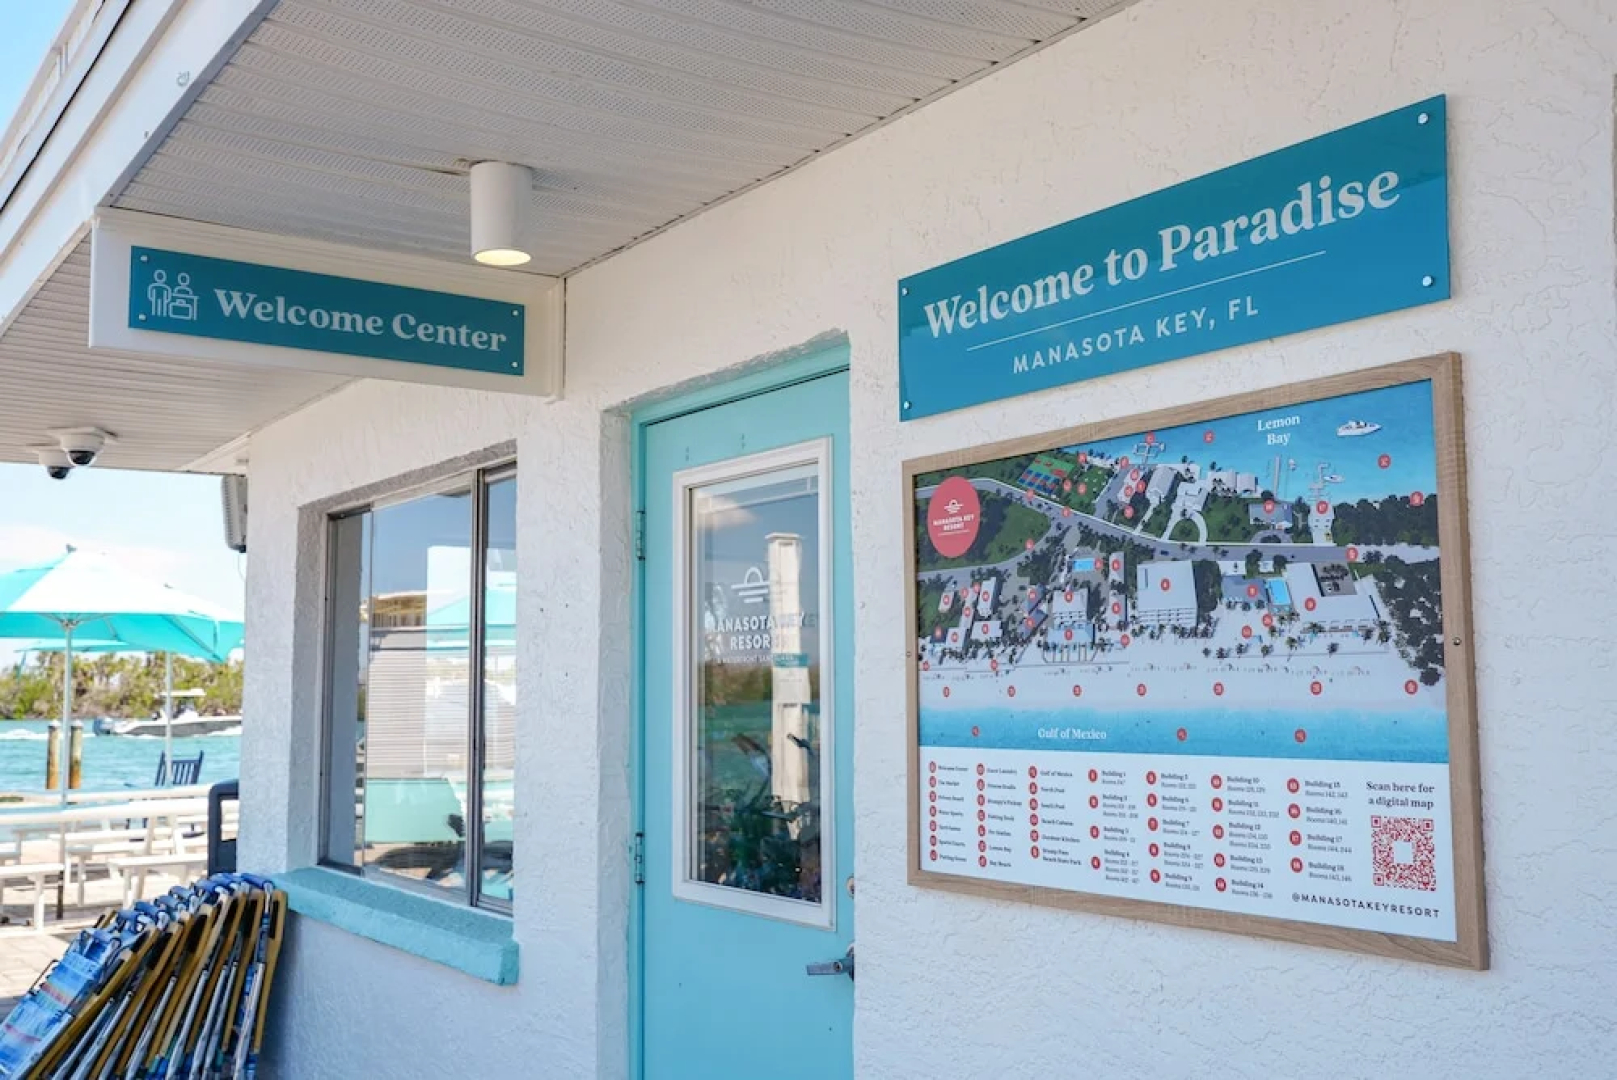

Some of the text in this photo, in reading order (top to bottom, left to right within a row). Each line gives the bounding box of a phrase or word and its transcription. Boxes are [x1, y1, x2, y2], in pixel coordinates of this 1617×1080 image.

[923, 169, 1400, 340] Welcome to Paradise
[214, 288, 507, 352] Welcome Center
[1012, 296, 1259, 374] MANASOTA KEY, FL
[1257, 416, 1300, 431] Lemon
[1267, 433, 1290, 446] Bay
[1038, 728, 1107, 739] Gulf of Mexico
[1227, 776, 1252, 784] Building
[1304, 780, 1332, 789] Building
[1366, 781, 1435, 793] Scan here for
[1162, 796, 1184, 804] Building
[1228, 800, 1252, 808] Building
[1376, 797, 1409, 808] digital
[1410, 800, 1434, 810] map
[1306, 806, 1332, 816] Building
[1162, 820, 1186, 828] Building
[1229, 822, 1253, 831] Building
[1307, 834, 1334, 842] Building
[1164, 842, 1186, 850] Building
[1230, 855, 1255, 864] Building
[1308, 862, 1335, 872] Building
[1165, 873, 1188, 881] Building
[1232, 880, 1256, 888] Building
[1292, 892, 1440, 918] @MANASOTAKEYRESORT
